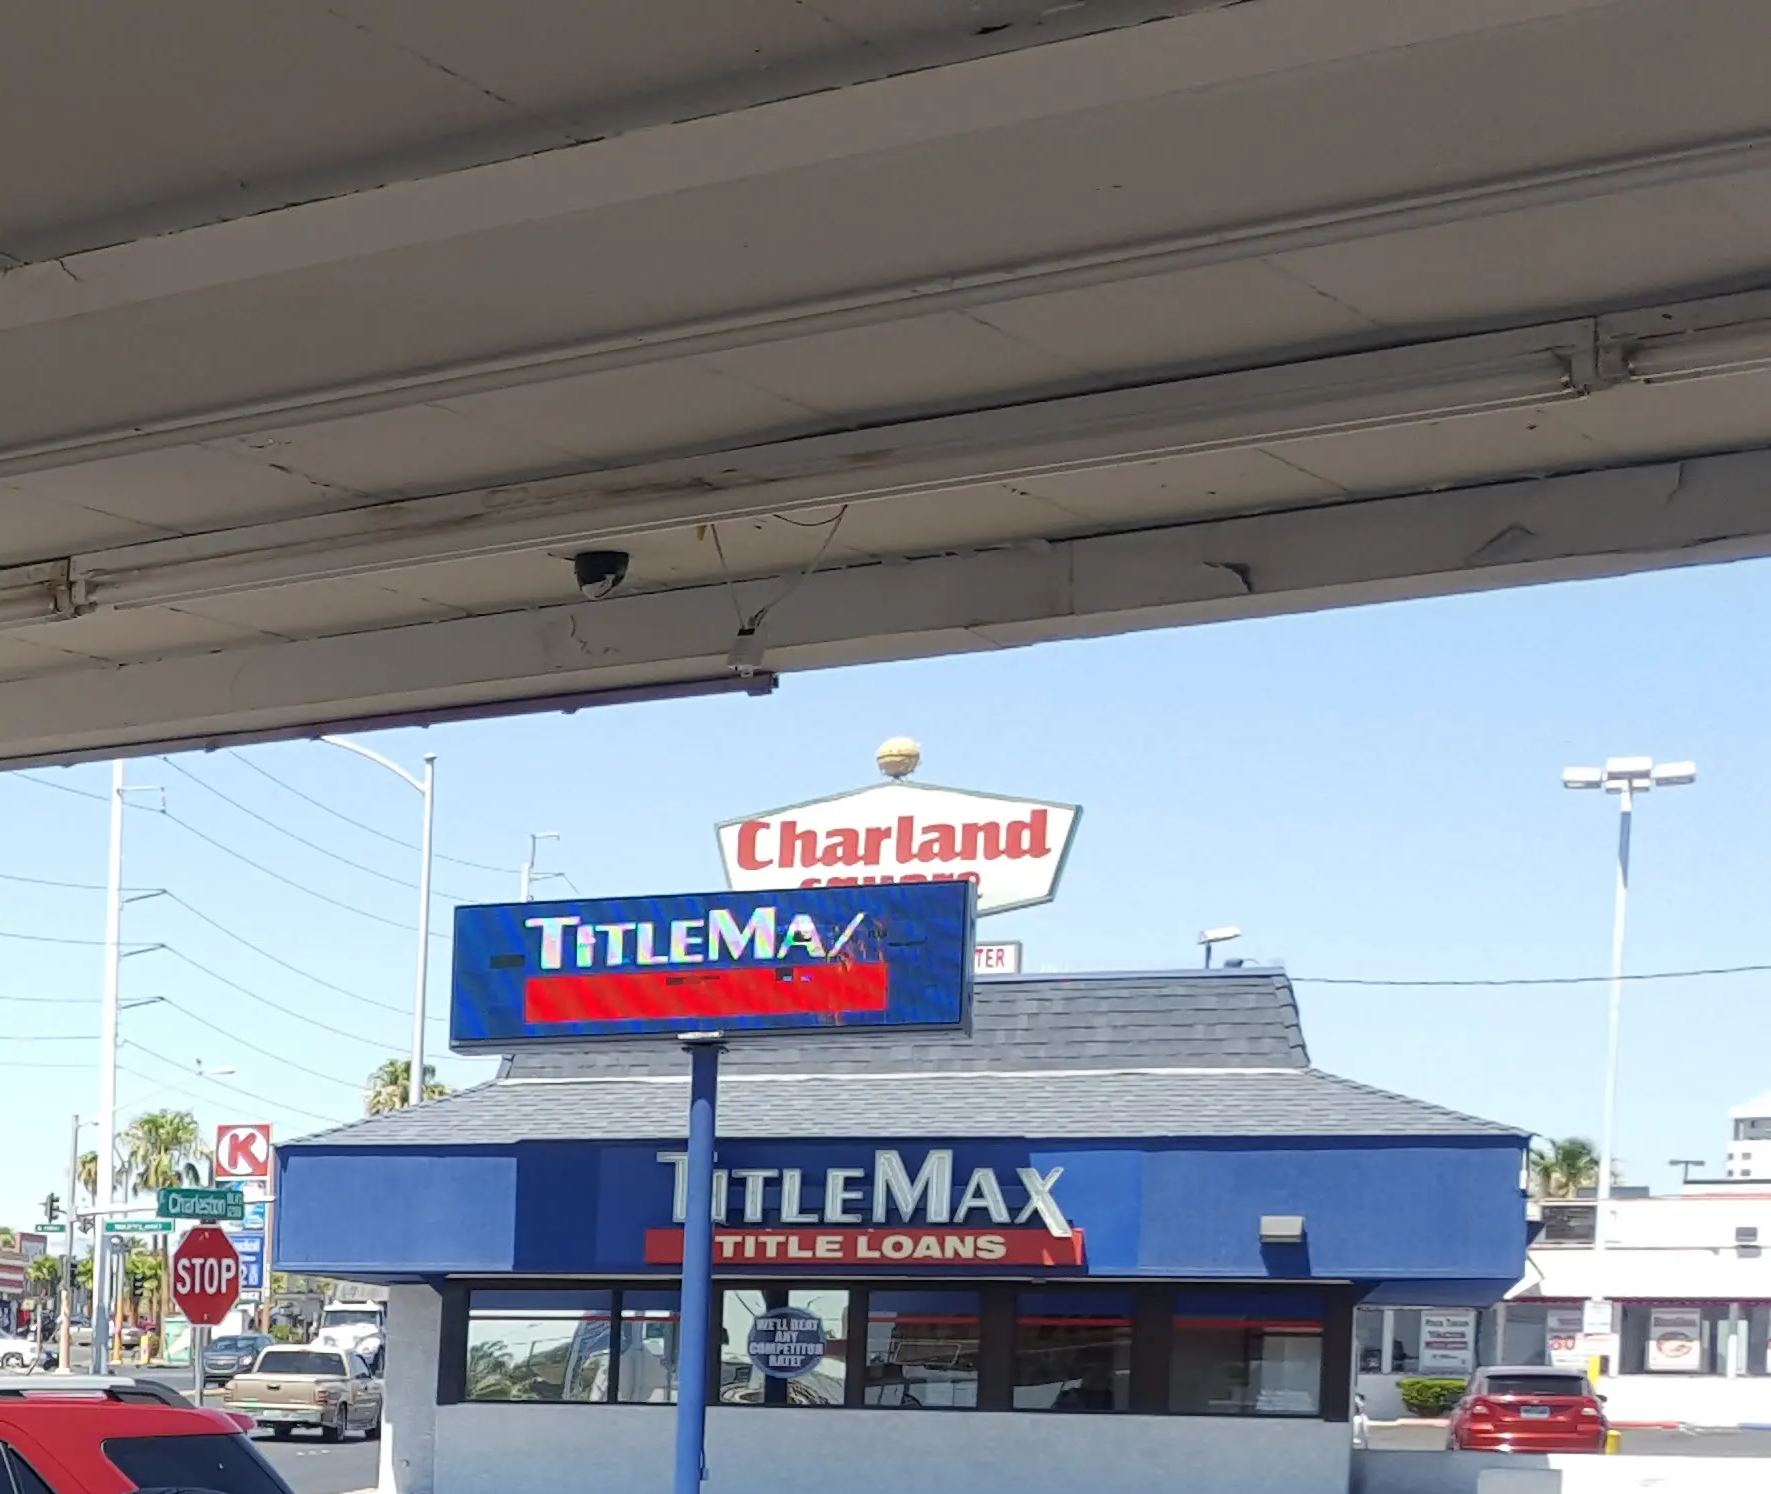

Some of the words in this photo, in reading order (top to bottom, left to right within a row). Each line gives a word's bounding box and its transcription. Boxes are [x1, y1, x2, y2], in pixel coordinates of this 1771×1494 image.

[736, 808, 1052, 871] Charland
[975, 947, 1006, 969] TER
[168, 1192, 226, 1216] Charleston
[714, 1234, 845, 1259] TITLE
[856, 1234, 1008, 1260] LOANS
[176, 1257, 237, 1296] STOP
